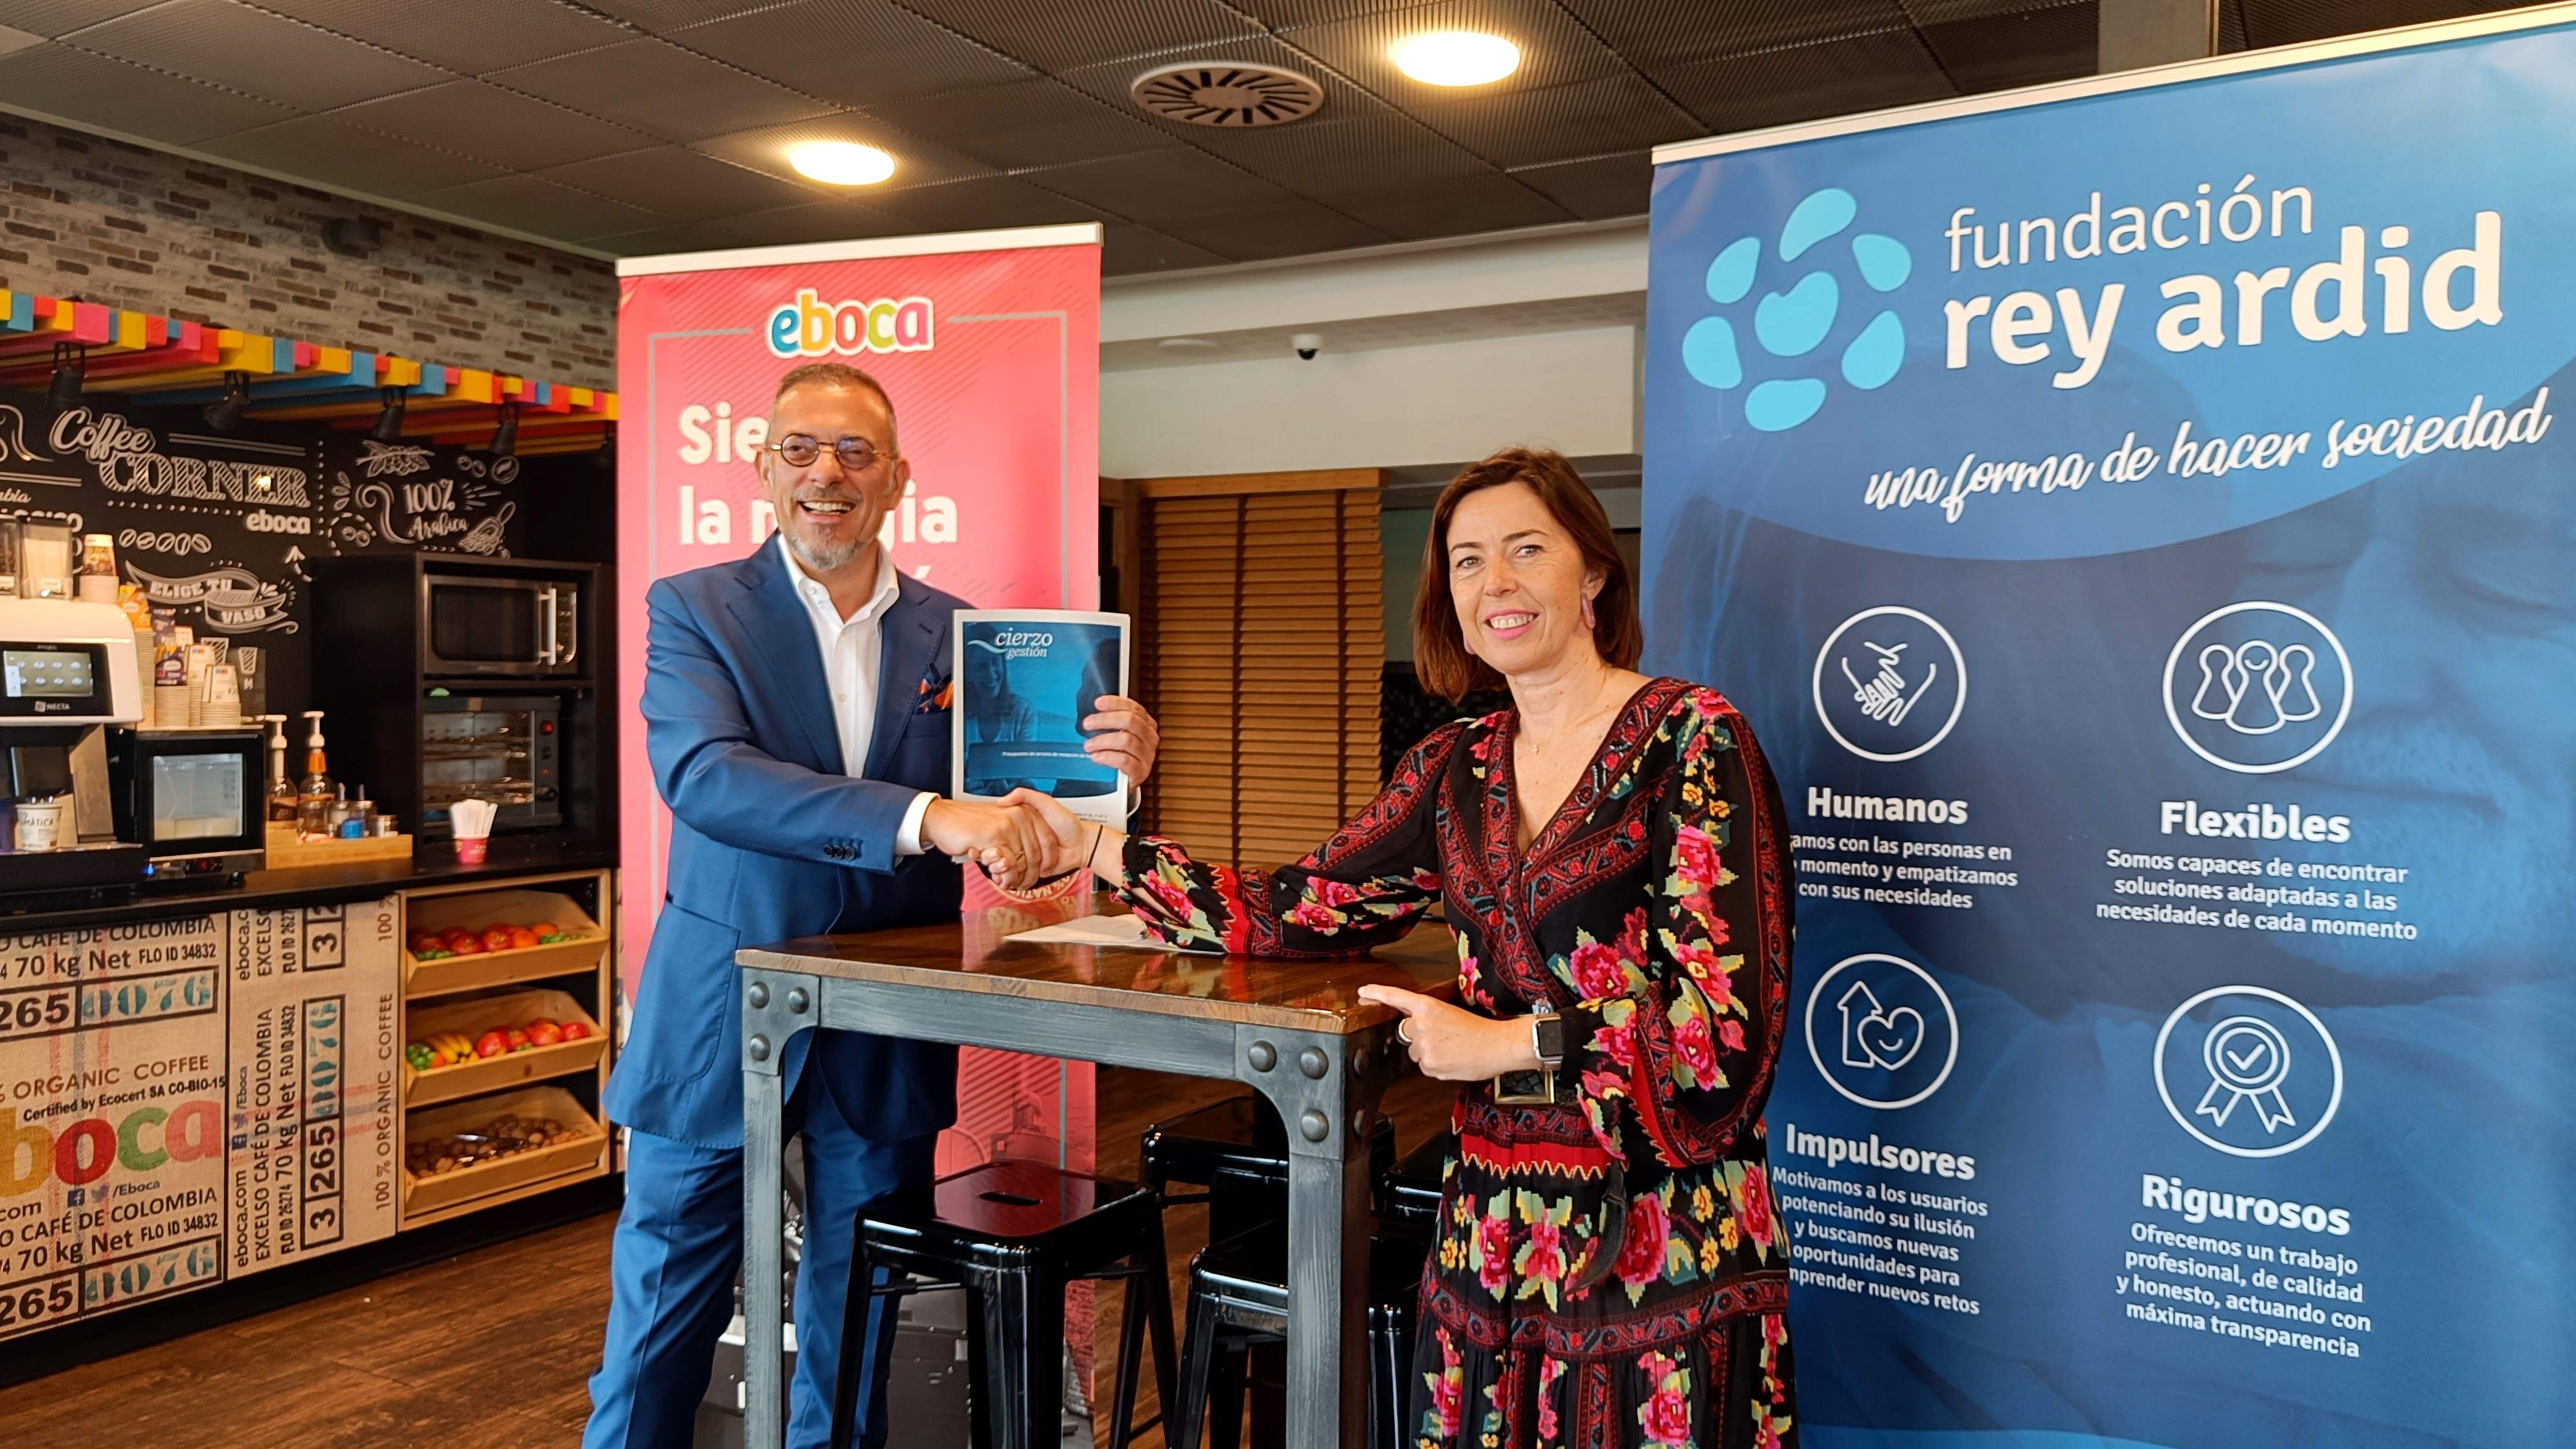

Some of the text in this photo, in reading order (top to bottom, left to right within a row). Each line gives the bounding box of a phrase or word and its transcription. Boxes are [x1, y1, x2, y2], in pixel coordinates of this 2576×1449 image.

[1944, 174, 2312, 272] fundación
[1944, 211, 2503, 388] rey ardid
[769, 289, 933, 356] eboca
[51, 408, 153, 461] Coffee
[1864, 387, 2552, 523] una forma de hacer sociedad
[99, 453, 311, 508] CORNER
[403, 478, 455, 514] 100%
[246, 509, 311, 534] eboca
[408, 514, 470, 541] Arabica
[679, 486, 730, 545] la
[149, 578, 232, 598] ELIGE TU
[221, 607, 266, 624] VASO
[996, 627, 1054, 647] cierzo
[1007, 645, 1047, 660] gestión
[1808, 787, 1969, 824] Humanos
[2161, 800, 2351, 842] Flexibles
[1791, 835, 2011, 861] amos con las personas en
[2107, 849, 2408, 883] Somos capaces de encontrar
[1802, 860, 1878, 877] momento
[1882, 866, 1892, 882] y
[1897, 865, 2018, 886] empatizamos
[1799, 883, 1972, 908] con sus necesidades
[2114, 876, 2397, 911] soluciones adaptadas a las
[77, 928, 102, 945] DE
[109, 917, 216, 941] COLOMBIA
[378, 914, 392, 941] 100
[2097, 903, 2417, 940] necesidades de cada momento
[16, 956, 45, 978] 70
[54, 952, 80, 977] kg
[89, 949, 131, 971] Net
[139, 949, 162, 965] FLO
[166, 947, 178, 961] ID
[182, 943, 217, 960] 34832
[236, 910, 251, 980] eboca.c
[312, 932, 337, 952] 3
[283, 952, 297, 974] FLO
[378, 993, 392, 1061] COFFEE
[280, 1042, 293, 1053] ID
[280, 1056, 294, 1077] FLO
[14, 1068, 120, 1099] ORGANIC
[134, 1055, 209, 1081] COFFEE
[23, 1098, 78, 1121] Certified
[82, 1096, 96, 1112] by
[99, 1088, 146, 1106] Ecocert
[150, 1085, 165, 1097] SA
[277, 1081, 296, 1121] Net
[377, 1070, 392, 1156] ORGANIC
[0, 1101, 222, 1197] boca
[251, 1008, 273, 1261] EXCELSO CAFÉ DE COLOMBIA
[275, 1125, 297, 1151] kg
[1787, 1123, 1975, 1180] Impulsores
[275, 1155, 293, 1181] 70
[310, 1125, 335, 1193] 265
[376, 1182, 390, 1210] 100
[1772, 1166, 1988, 1217] Motivamos a los usuarios
[2142, 1174, 2351, 1235] Rigurosos
[21, 1212, 73, 1242] CAFÉ
[79, 1210, 105, 1230] DE
[111, 1187, 217, 1222] COLOMBIA
[234, 1169, 248, 1267] eboca.com
[279, 1219, 292, 1230] ID
[310, 1208, 335, 1230] 3
[1783, 1195, 1974, 1239] potenciando su ilusión
[18, 1246, 47, 1270] 70
[57, 1242, 83, 1263] kg
[92, 1231, 132, 1255] Net
[141, 1225, 164, 1242] FLO
[168, 1222, 180, 1235] ID
[183, 1213, 218, 1231] 34832
[280, 1232, 295, 1254] FLO
[1794, 1220, 1959, 1261] y buscamos nuevas
[2131, 1222, 2358, 1277] Ofrecemos un trabajo
[1793, 1244, 1960, 1286] oportunidades para
[2125, 1250, 2364, 1303] profesional, de calidad
[0, 1279, 73, 1323] 265
[1869, 1281, 1930, 1305] nuevos
[1934, 1293, 1980, 1315] retos
[2116, 1274, 2373, 1332] y honesto, actuando con
[2127, 1301, 2360, 1358] máxima transparencia
